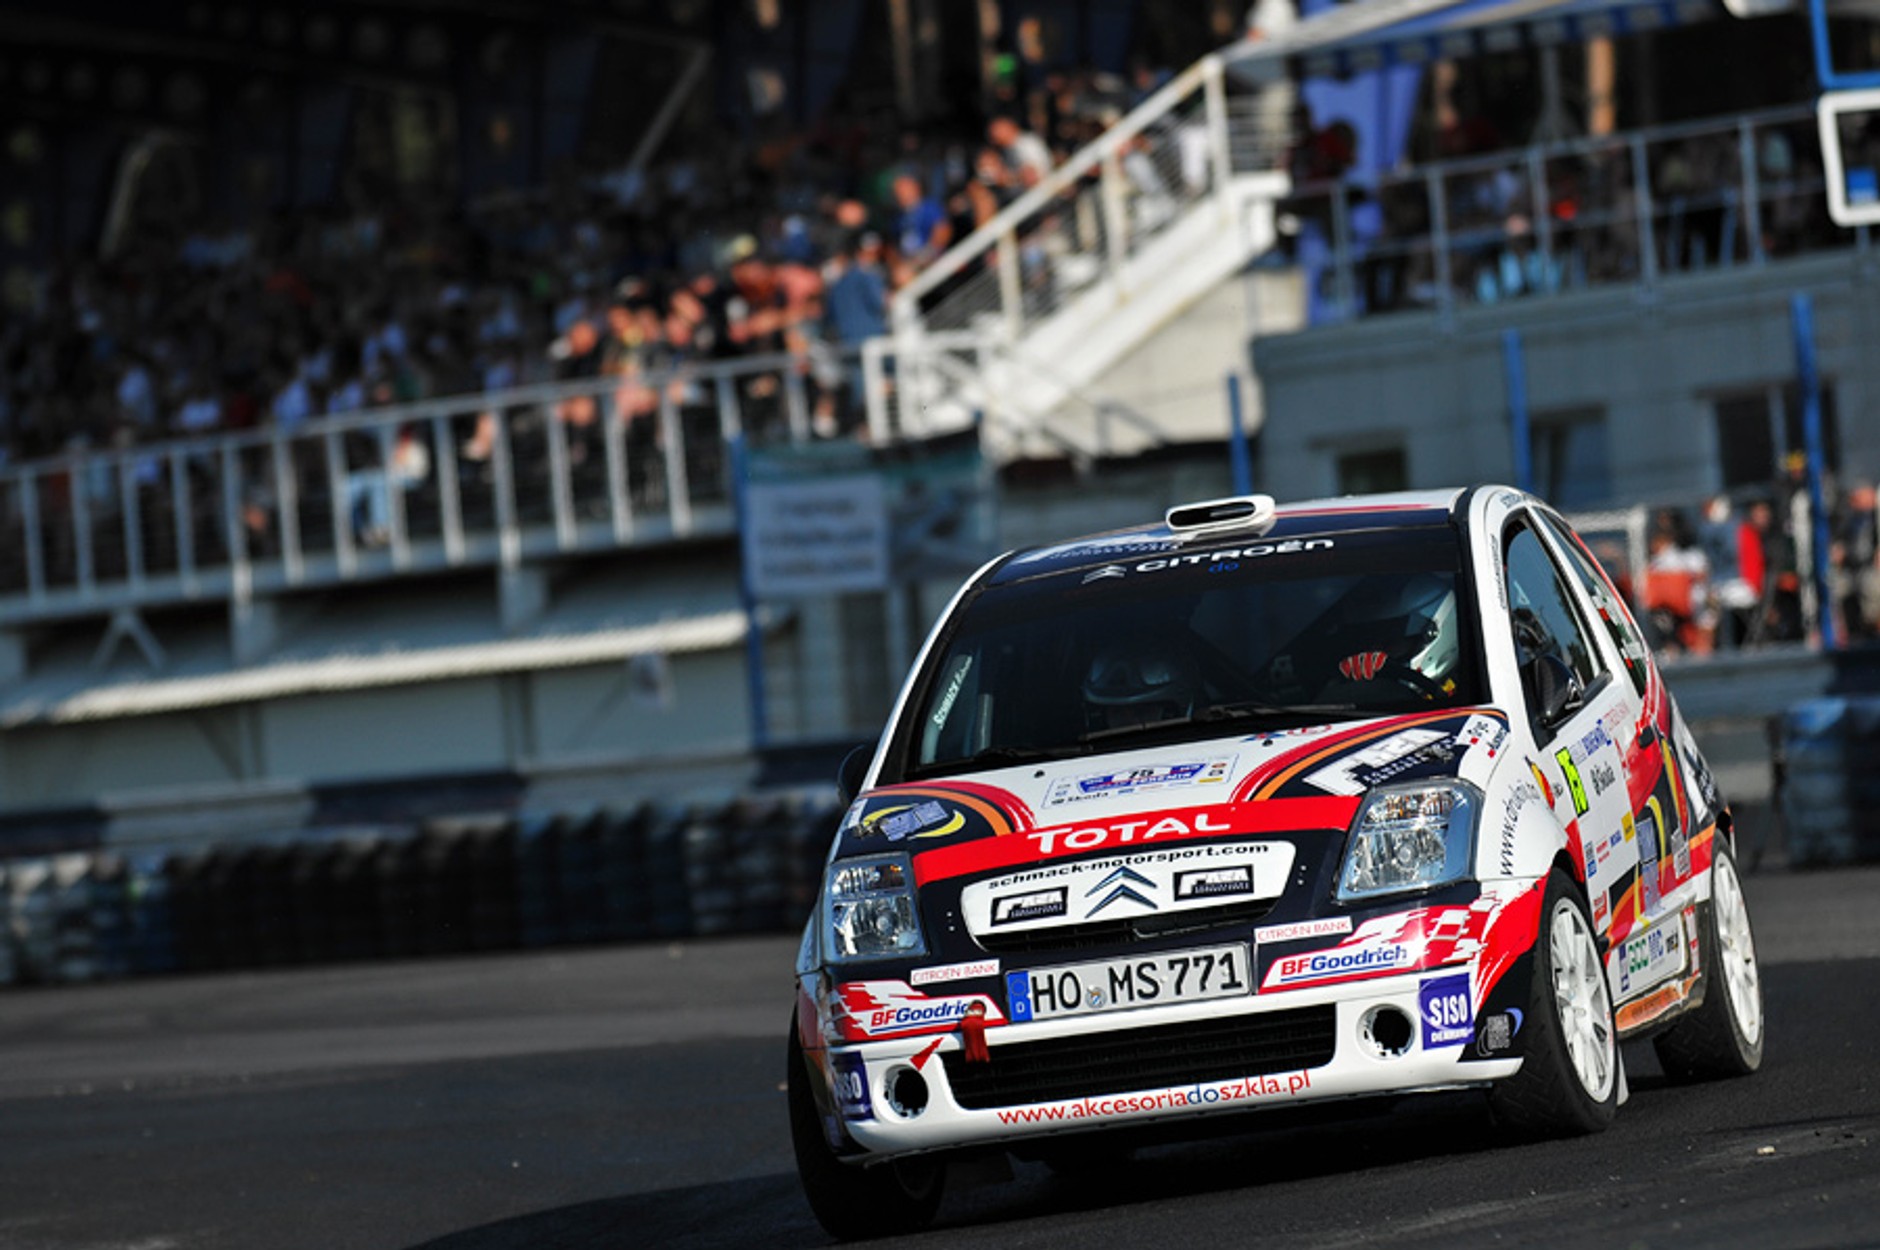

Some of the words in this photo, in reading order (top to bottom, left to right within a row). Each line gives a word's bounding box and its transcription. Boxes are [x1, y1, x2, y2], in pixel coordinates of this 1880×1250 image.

[1027, 813, 1231, 854] TOTAL
[988, 844, 1270, 890] schmack-motorsport.com
[1313, 920, 1350, 934] BANK
[963, 963, 997, 978] BANK
[1280, 944, 1407, 977] BFGoodrich
[1031, 971, 1081, 1012] HO
[1108, 962, 1160, 1004] MS
[1168, 952, 1243, 996] 771
[870, 1000, 970, 1027] BFGoodric
[1428, 993, 1468, 1027] SISO
[997, 1069, 1311, 1125] www.akcesoriadoszkla.pl
